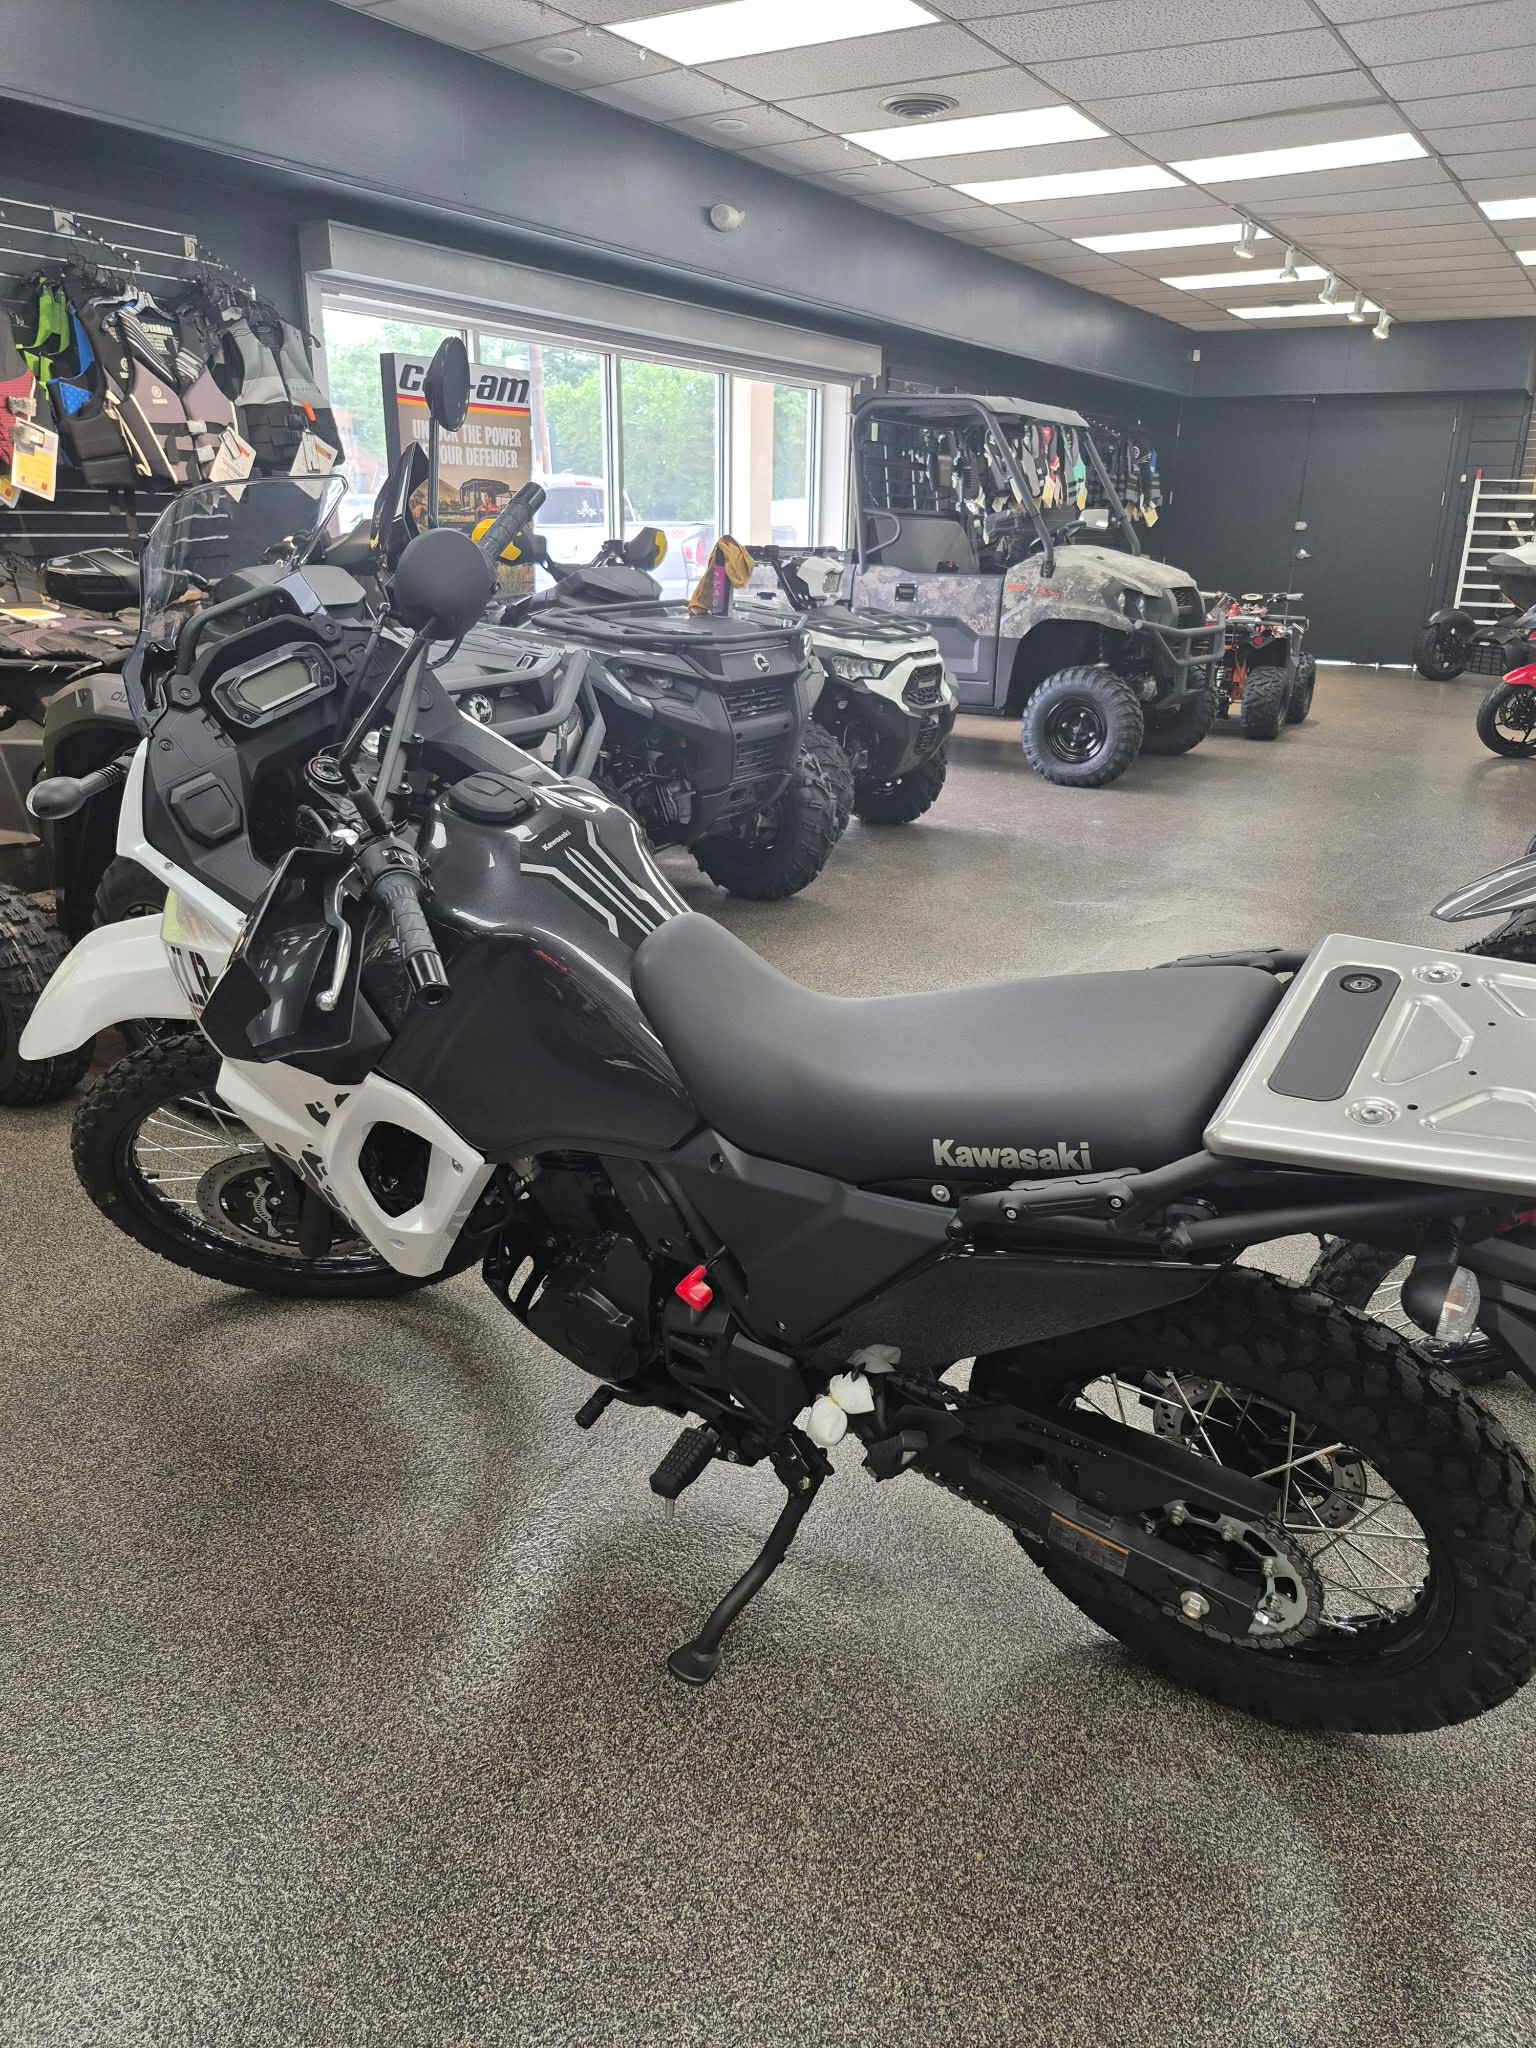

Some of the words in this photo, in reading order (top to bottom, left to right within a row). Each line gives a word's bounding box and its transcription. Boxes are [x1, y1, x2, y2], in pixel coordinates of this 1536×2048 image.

[399, 364, 530, 403] c-am
[464, 424, 482, 444] THE
[485, 427, 522, 447] POWER
[436, 445, 463, 465] OUR
[467, 448, 519, 468] DEFENDER
[542, 830, 571, 851] Kawasaki
[932, 1138, 1092, 1170] Kawasaki
